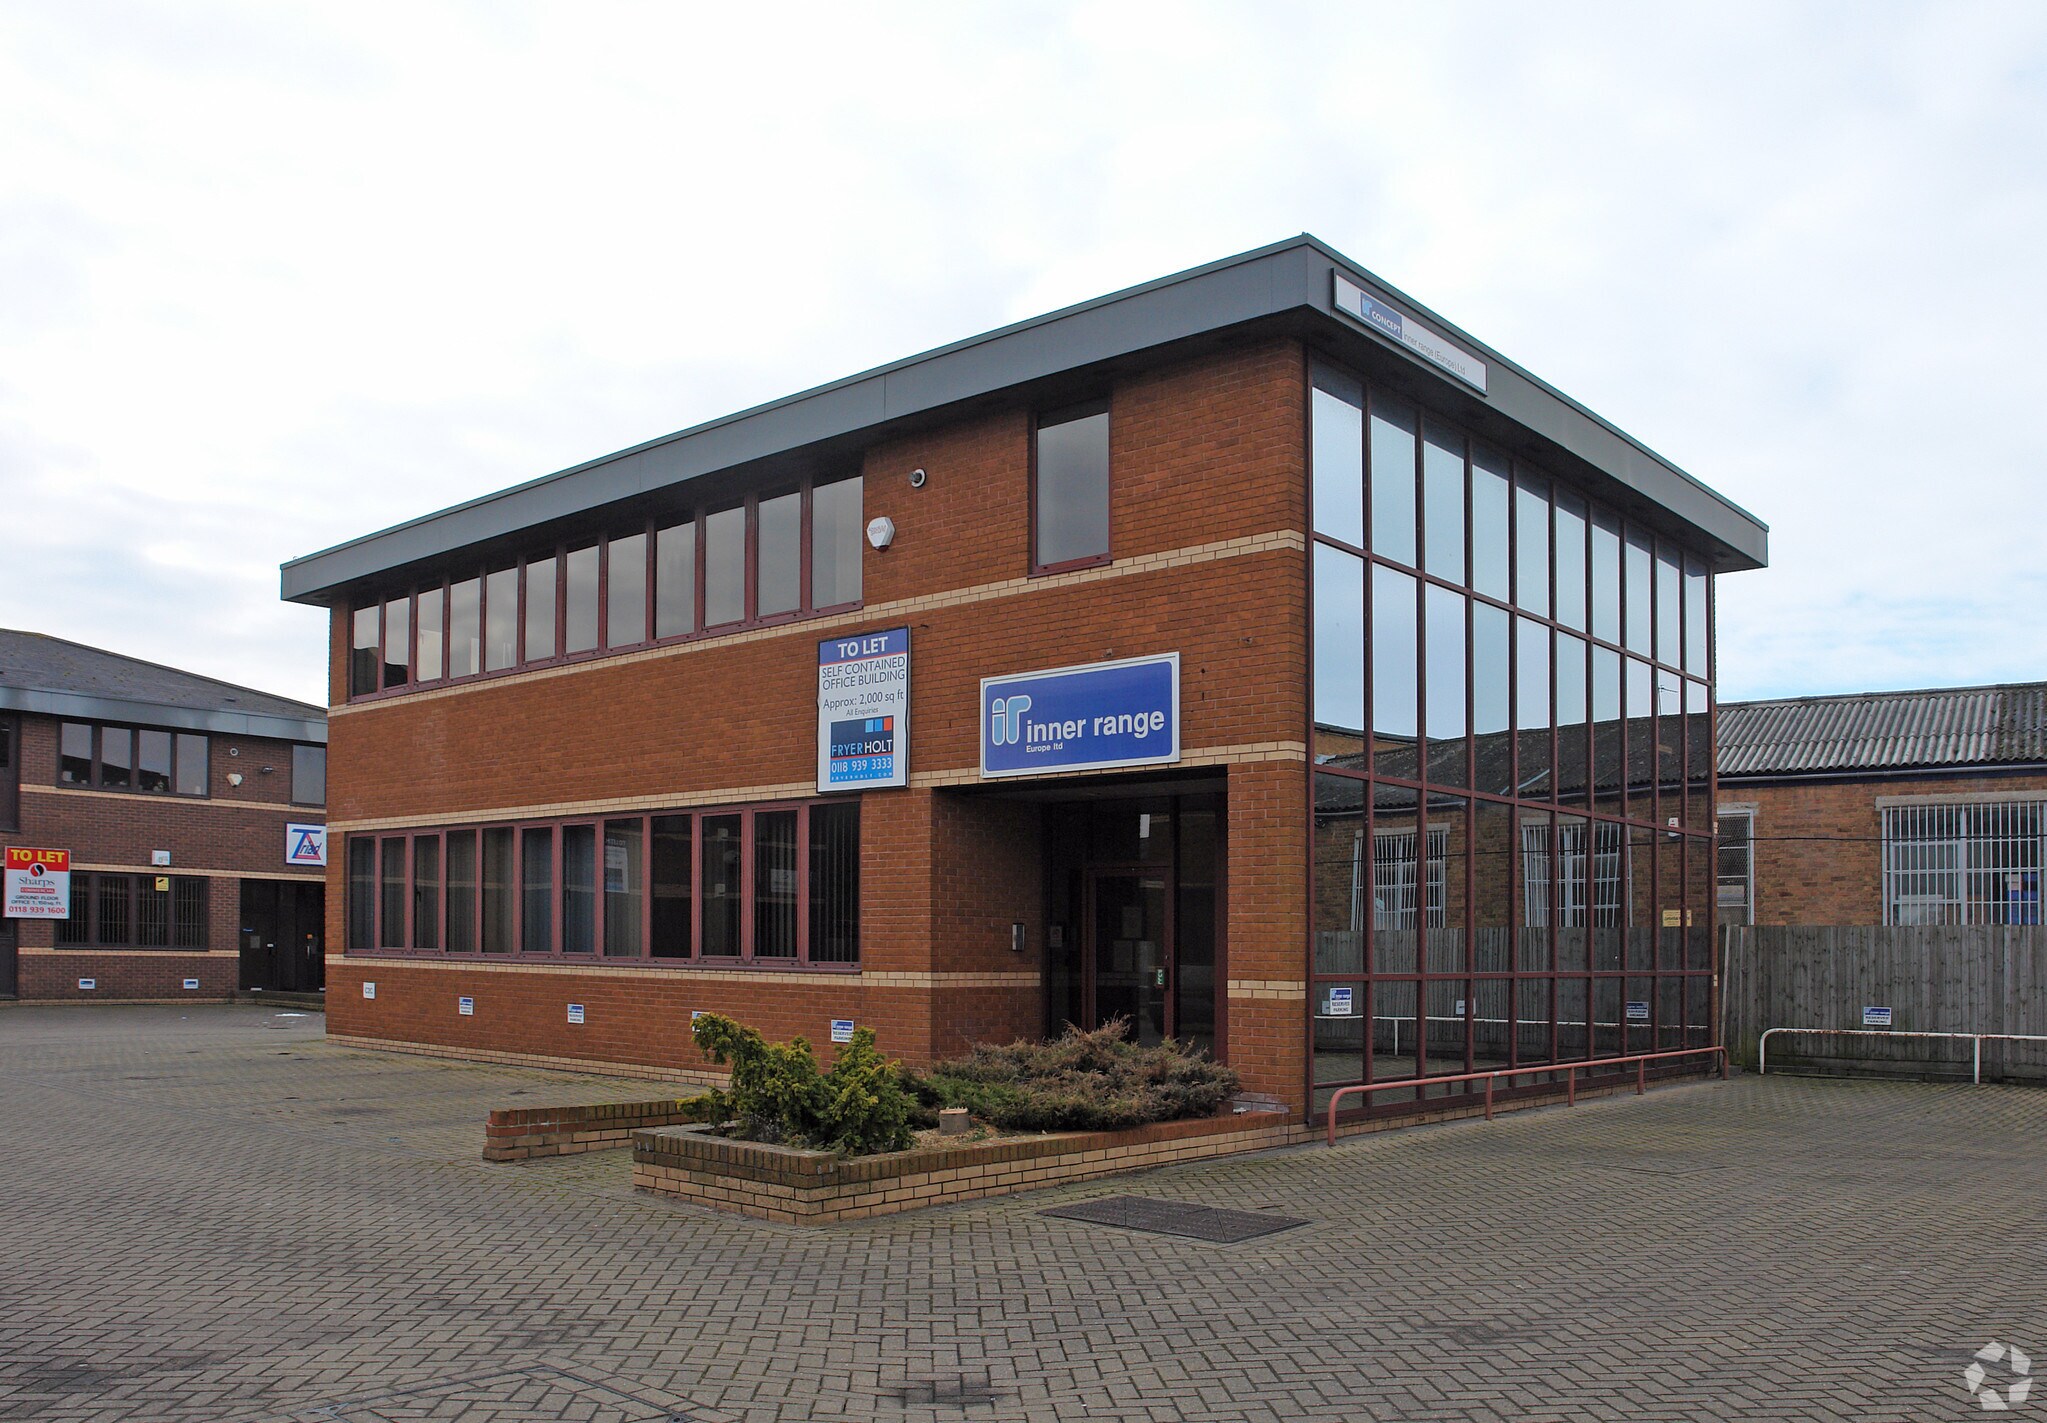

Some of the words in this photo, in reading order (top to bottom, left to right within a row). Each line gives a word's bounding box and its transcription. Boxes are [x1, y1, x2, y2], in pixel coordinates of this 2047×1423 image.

[1372, 311, 1401, 334] CONCEPT
[1418, 342, 1434, 357] range
[838, 642, 858, 658] TO
[863, 636, 888, 654] LET
[822, 666, 842, 678] SELF
[844, 656, 906, 675] CONTAINED
[822, 676, 856, 690] OFFICE
[858, 669, 905, 686] BUILDING
[823, 698, 857, 711] Approx:
[860, 692, 883, 706] 2,000
[885, 692, 894, 704] sq
[898, 689, 904, 700] ft
[854, 707, 879, 716] Enquiries
[1026, 718, 1086, 743] inner
[1094, 710, 1165, 739] range
[1026, 744, 1051, 753] Europe
[1053, 742, 1063, 750] ltd
[832, 762, 848, 773] 0118
[852, 760, 868, 772] 939
[872, 758, 892, 770] 3333
[10, 849, 32, 862] TO
[37, 850, 65, 863] LET
[19, 876, 55, 888] Sharps
